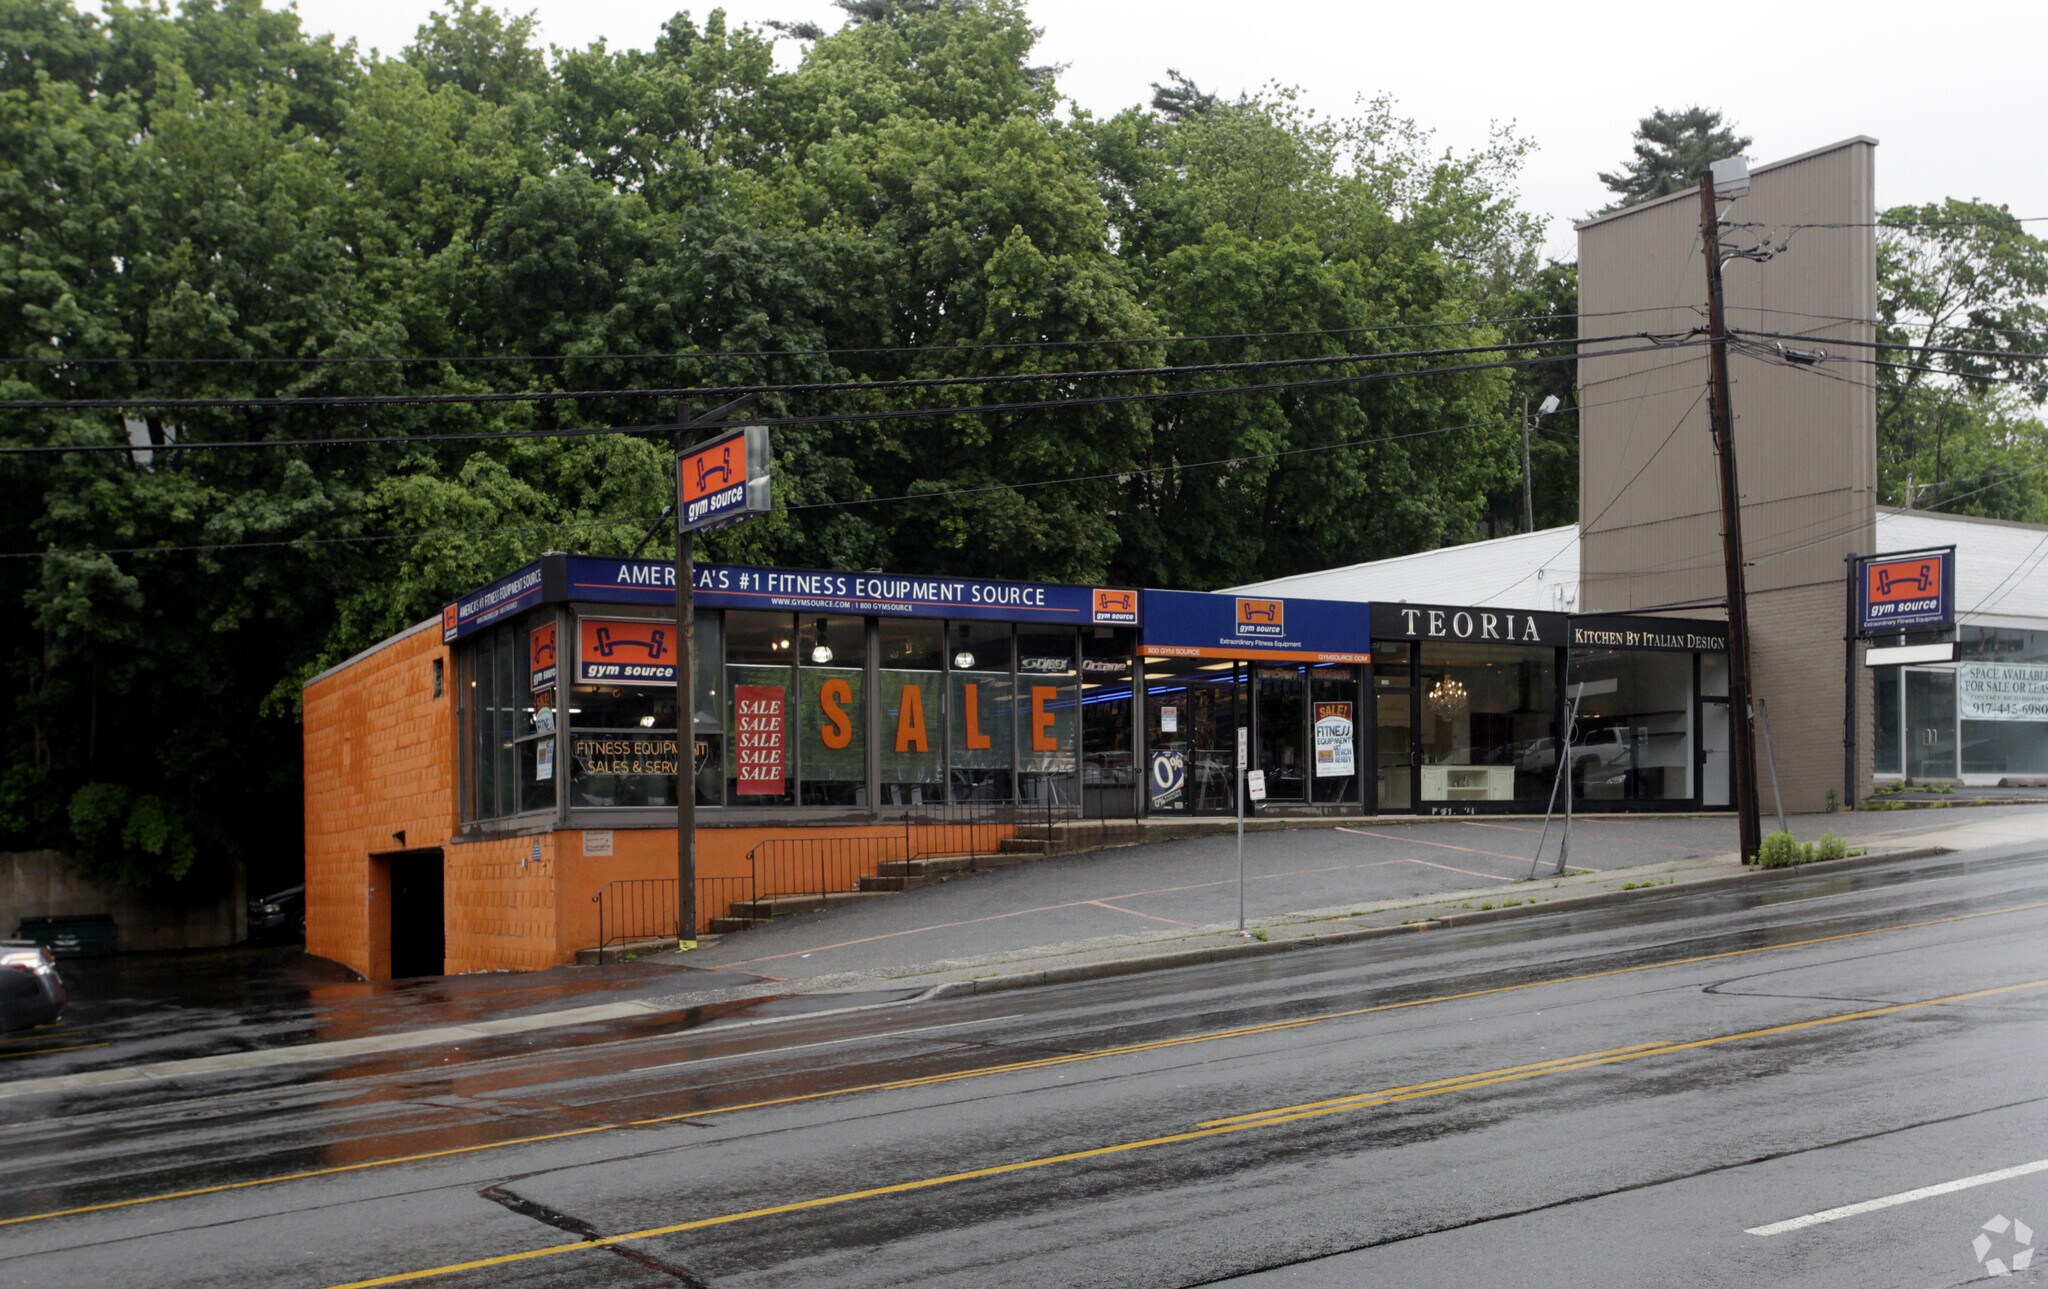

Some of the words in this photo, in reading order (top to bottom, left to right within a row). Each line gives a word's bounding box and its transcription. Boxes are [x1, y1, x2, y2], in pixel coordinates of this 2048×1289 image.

[689, 498, 708, 522] gym
[710, 486, 743, 510] source
[523, 569, 541, 589] SOURCE
[617, 565, 729, 589] AMERA'S
[739, 572, 760, 591] #1
[768, 574, 846, 595] FITNESS
[856, 579, 965, 600] EQUIPMENT
[972, 585, 1045, 606] SOURCE
[771, 598, 850, 609] WWW.GYMSOURCE.COM
[873, 602, 912, 612] GYMSOURCE
[1871, 603, 1895, 617] gym
[1898, 600, 1937, 612] source
[1097, 613, 1111, 621] gym
[1864, 619, 1897, 628] Extraordinary
[1240, 625, 1255, 633] gym
[1256, 625, 1280, 633] source
[1401, 609, 1540, 642] TEORIA
[1220, 638, 1254, 647] Extraordinary
[1255, 639, 1274, 647] Fitness
[1274, 640, 1302, 648] Equipment
[1575, 628, 1624, 645] KITCHEN
[1643, 632, 1684, 648] ITALIAN
[1687, 634, 1725, 649] DESIGN
[1160, 647, 1174, 655] GYM
[588, 664, 619, 677] gym
[624, 665, 673, 677] source
[1082, 660, 1126, 671] Octane
[1970, 668, 1999, 680] SPACE
[1965, 680, 1984, 691] FOR
[1986, 681, 2010, 692] SALE
[2012, 682, 2026, 693] OR
[739, 700, 781, 714] SALE
[1320, 704, 1348, 718] SALE!
[1972, 702, 2048, 715] 917-445-6980
[820, 679, 1057, 752] SALE
[739, 717, 781, 731] SALE
[1317, 725, 1350, 737] FITNESS
[739, 734, 781, 748] SALE
[1317, 737, 1351, 745] EQUIPMENT
[576, 742, 630, 755] FITNESS
[635, 742, 705, 756] EQUIPMNT
[739, 750, 781, 764] SALE
[588, 760, 628, 773] SALES
[633, 760, 641, 773] &
[645, 760, 697, 774] SERV
[739, 766, 781, 780] SALE
[1154, 755, 1183, 788] 0%
